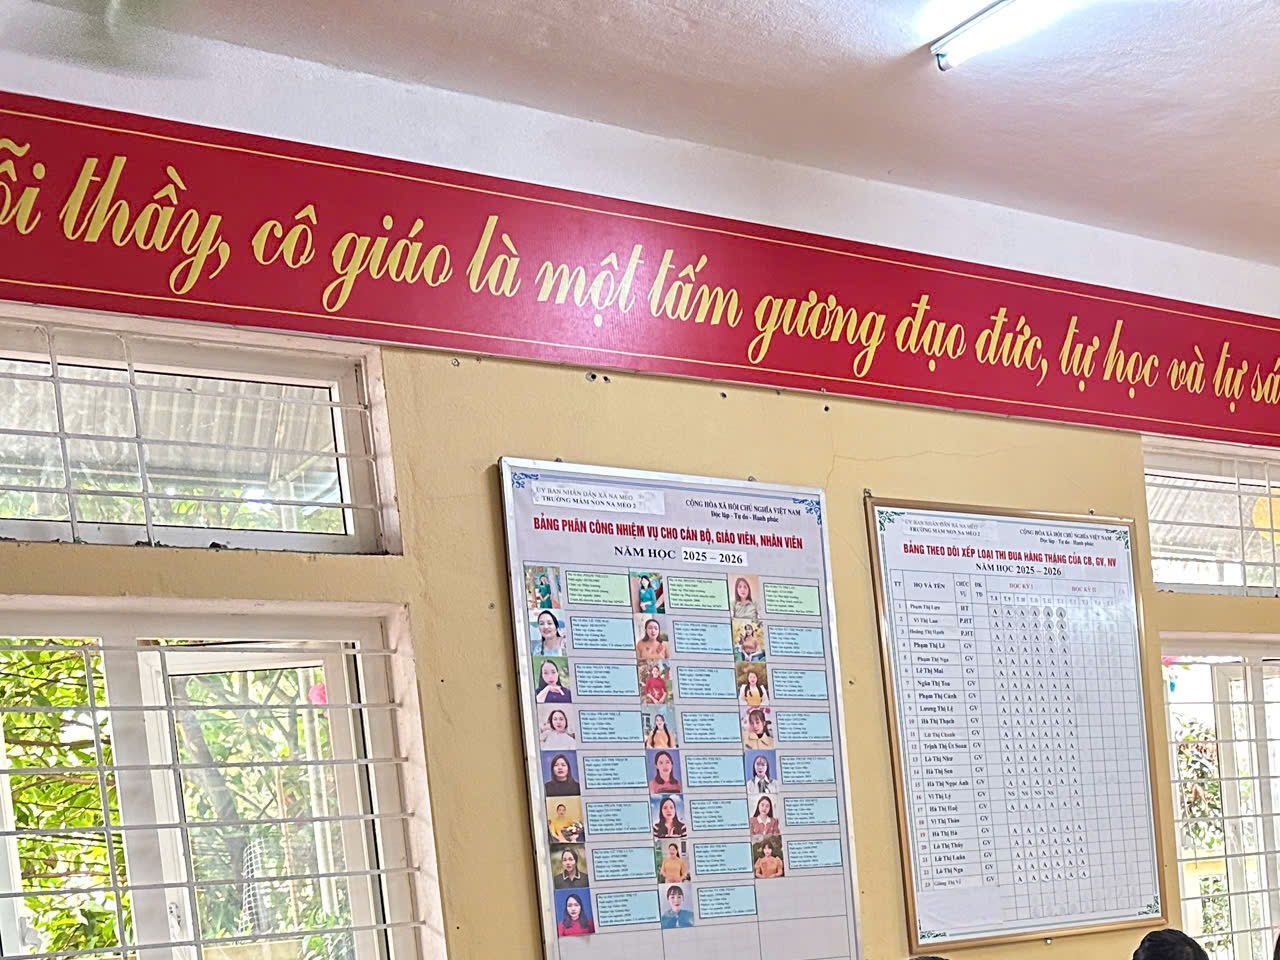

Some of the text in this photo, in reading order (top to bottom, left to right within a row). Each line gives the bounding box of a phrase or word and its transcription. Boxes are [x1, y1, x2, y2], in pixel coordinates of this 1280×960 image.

[60, 156, 230, 294] thầy,
[252, 204, 318, 268] cô
[322, 215, 452, 312] giáo
[466, 216, 522, 297] là
[535, 244, 644, 328] một
[648, 249, 744, 328] tấm
[748, 290, 886, 378] gương
[896, 294, 966, 372] đạo
[974, 307, 1050, 386] đức,
[1060, 316, 1100, 392] tự
[1102, 319, 1160, 398] học
[1167, 346, 1207, 394] và
[1213, 342, 1248, 414] tự
[534, 512, 560, 530] BẢNG
[562, 518, 586, 533] PHÂN
[590, 519, 614, 534] CÔNG
[616, 522, 645, 540] NHIỆM
[648, 526, 658, 541] VỤ
[661, 527, 678, 540] CHO
[680, 526, 698, 541] CÁN
[700, 528, 714, 545] BỘ,
[716, 530, 736, 544] GIÁO
[761, 533, 782, 548] NHÂN
[784, 535, 803, 549] VIÊN
[614, 544, 644, 558] NĂM
[648, 548, 676, 561] HỌC
[683, 550, 708, 562] 2025
[720, 552, 742, 564] 2026
[904, 540, 924, 554] BẢNG
[926, 545, 945, 556] THEO
[962, 545, 976, 558] XẾP
[978, 549, 994, 561] LOẠI
[995, 550, 1006, 560] THI
[1008, 551, 1022, 561] ĐUA
[1045, 552, 1066, 564] THÁNG
[1108, 558, 1116, 567] NV
[997, 564, 1014, 574] HỌC
[1016, 566, 1034, 574] 2025
[1044, 566, 1062, 576] 2026
